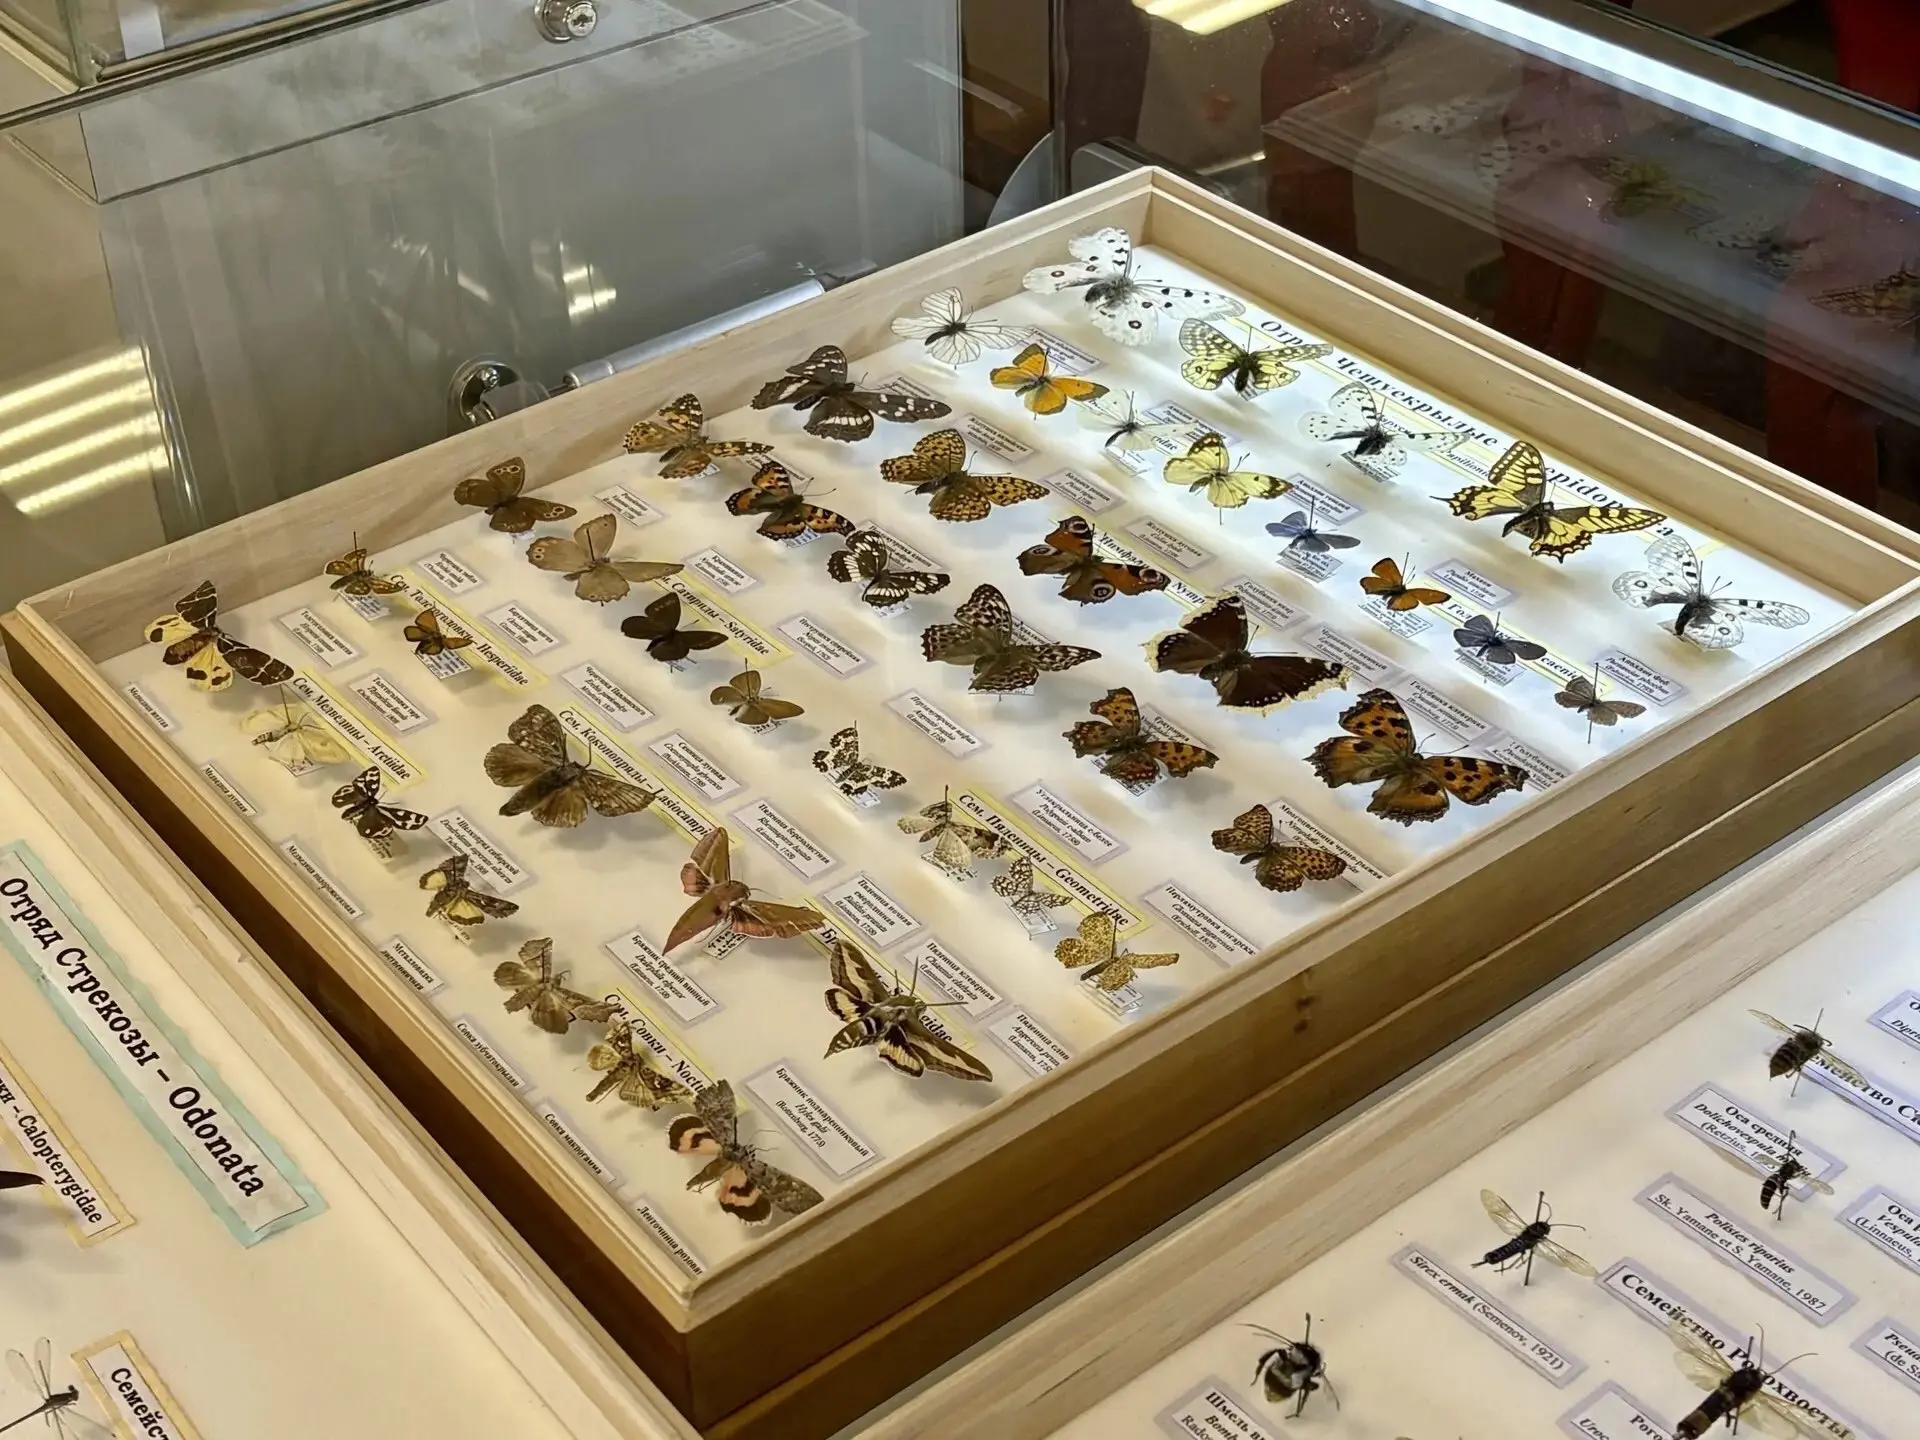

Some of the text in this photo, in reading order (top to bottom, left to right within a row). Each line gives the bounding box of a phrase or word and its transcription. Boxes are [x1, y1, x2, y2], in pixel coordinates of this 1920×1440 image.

[1324, 356, 1501, 446] Чешуекрылые
[669, 581, 721, 619] Сатириды
[721, 620, 771, 655] Satyridae
[474, 642, 530, 686] Hesperiidae
[291, 676, 316, 698] Сем.
[311, 694, 366, 741] Медведицы
[366, 744, 412, 780] Arctiidae
[557, 709, 583, 730] Сем.
[756, 803, 789, 829] Пяденица
[957, 793, 987, 817] Сем.
[984, 814, 1048, 863] Пяденицы
[1053, 867, 1131, 926] Geometridae
[1163, 885, 1226, 930] Перламутровка
[630, 934, 711, 1007] Бражник средний винный
[925, 942, 996, 1001] Пяденица клеверная
[1, 876, 64, 950] Отряд
[55, 946, 161, 1082] Стрекозы
[168, 1084, 265, 1198] Odonata
[455, 1022, 478, 1043] Совка
[625, 1017, 668, 1054] Совки
[1015, 1013, 1053, 1045] Пяденица
[774, 1067, 870, 1157] Бражник подмаренниковый
[1692, 1101, 1777, 1161] Dolichovespula
[1699, 1120, 1747, 1154] (Retzius,
[1724, 1105, 1803, 1161] Оса средняя
[18, 1114, 103, 1224] Calopterygidae
[542, 1112, 603, 1175] Совка макрогамма
[635, 1205, 680, 1249] Ленточница
[1703, 1211, 1795, 1275] Polistes riparius
[1854, 1215, 1914, 1261] (Linnaeus,
[1886, 1203, 1915, 1225] Оса
[1653, 1193, 1827, 1313] Sk. Yamane et S. Yamane, 1987
[1408, 1255, 1565, 1370] Sirex ermak (Semenov, 1921)
[1619, 1272, 1727, 1354] Семейство
[1884, 1349, 1907, 1368] (de
[1203, 1391, 1256, 1432] Шмель
